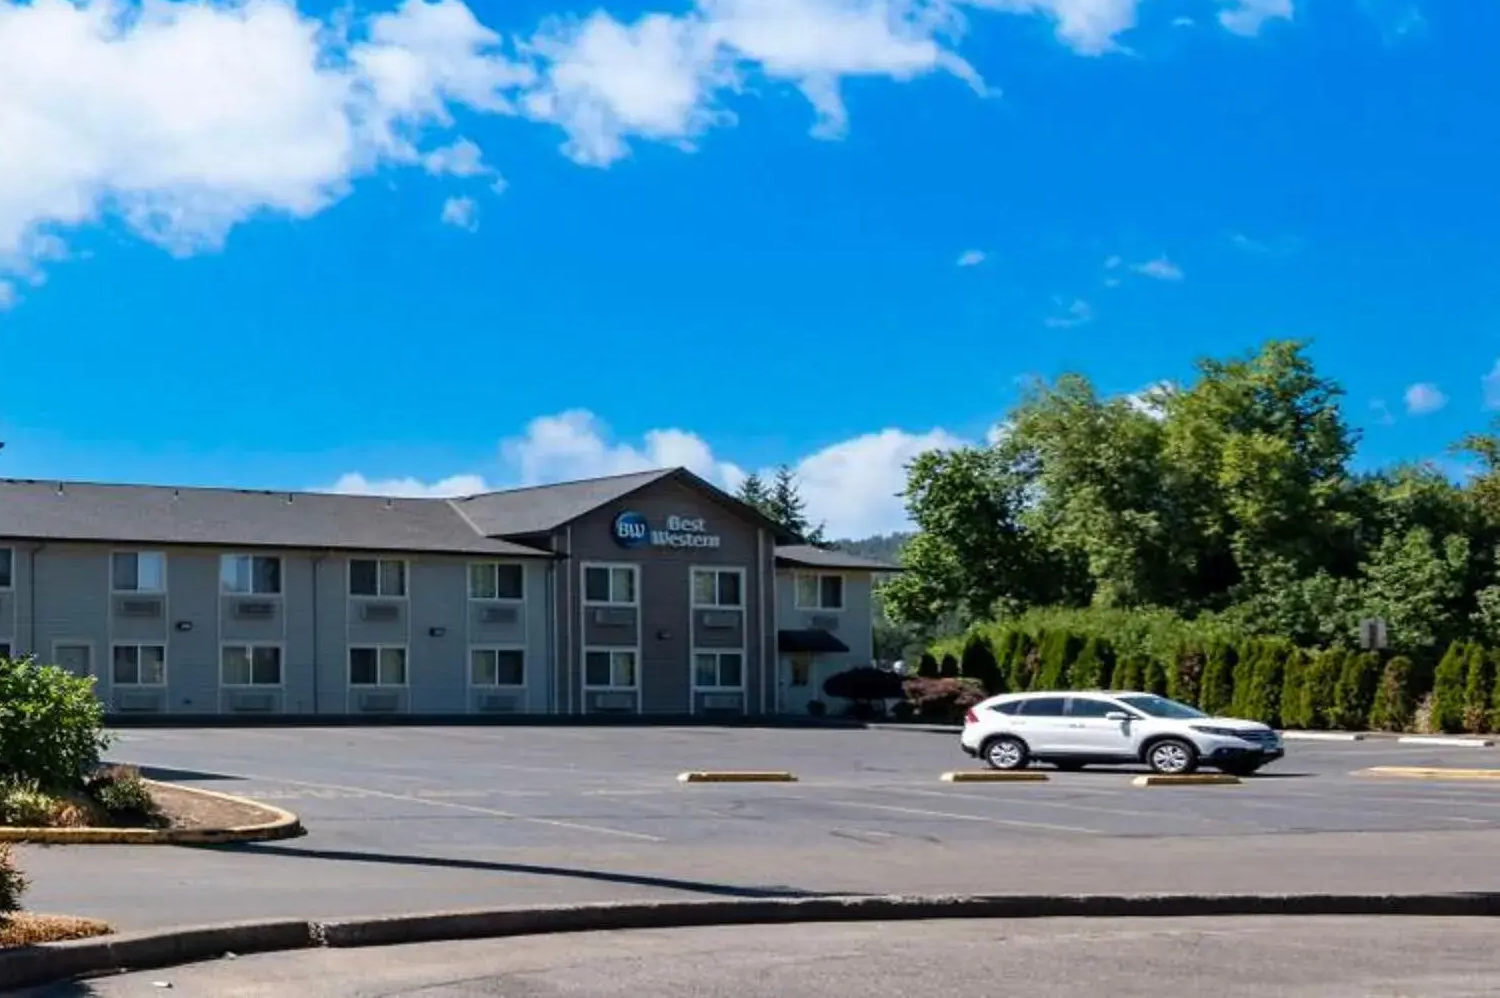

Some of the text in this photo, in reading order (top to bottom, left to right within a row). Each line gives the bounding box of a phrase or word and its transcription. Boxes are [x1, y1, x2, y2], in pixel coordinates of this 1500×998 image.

[618, 521, 646, 538] BW
[666, 515, 706, 532] Best
[650, 530, 720, 548] Western
